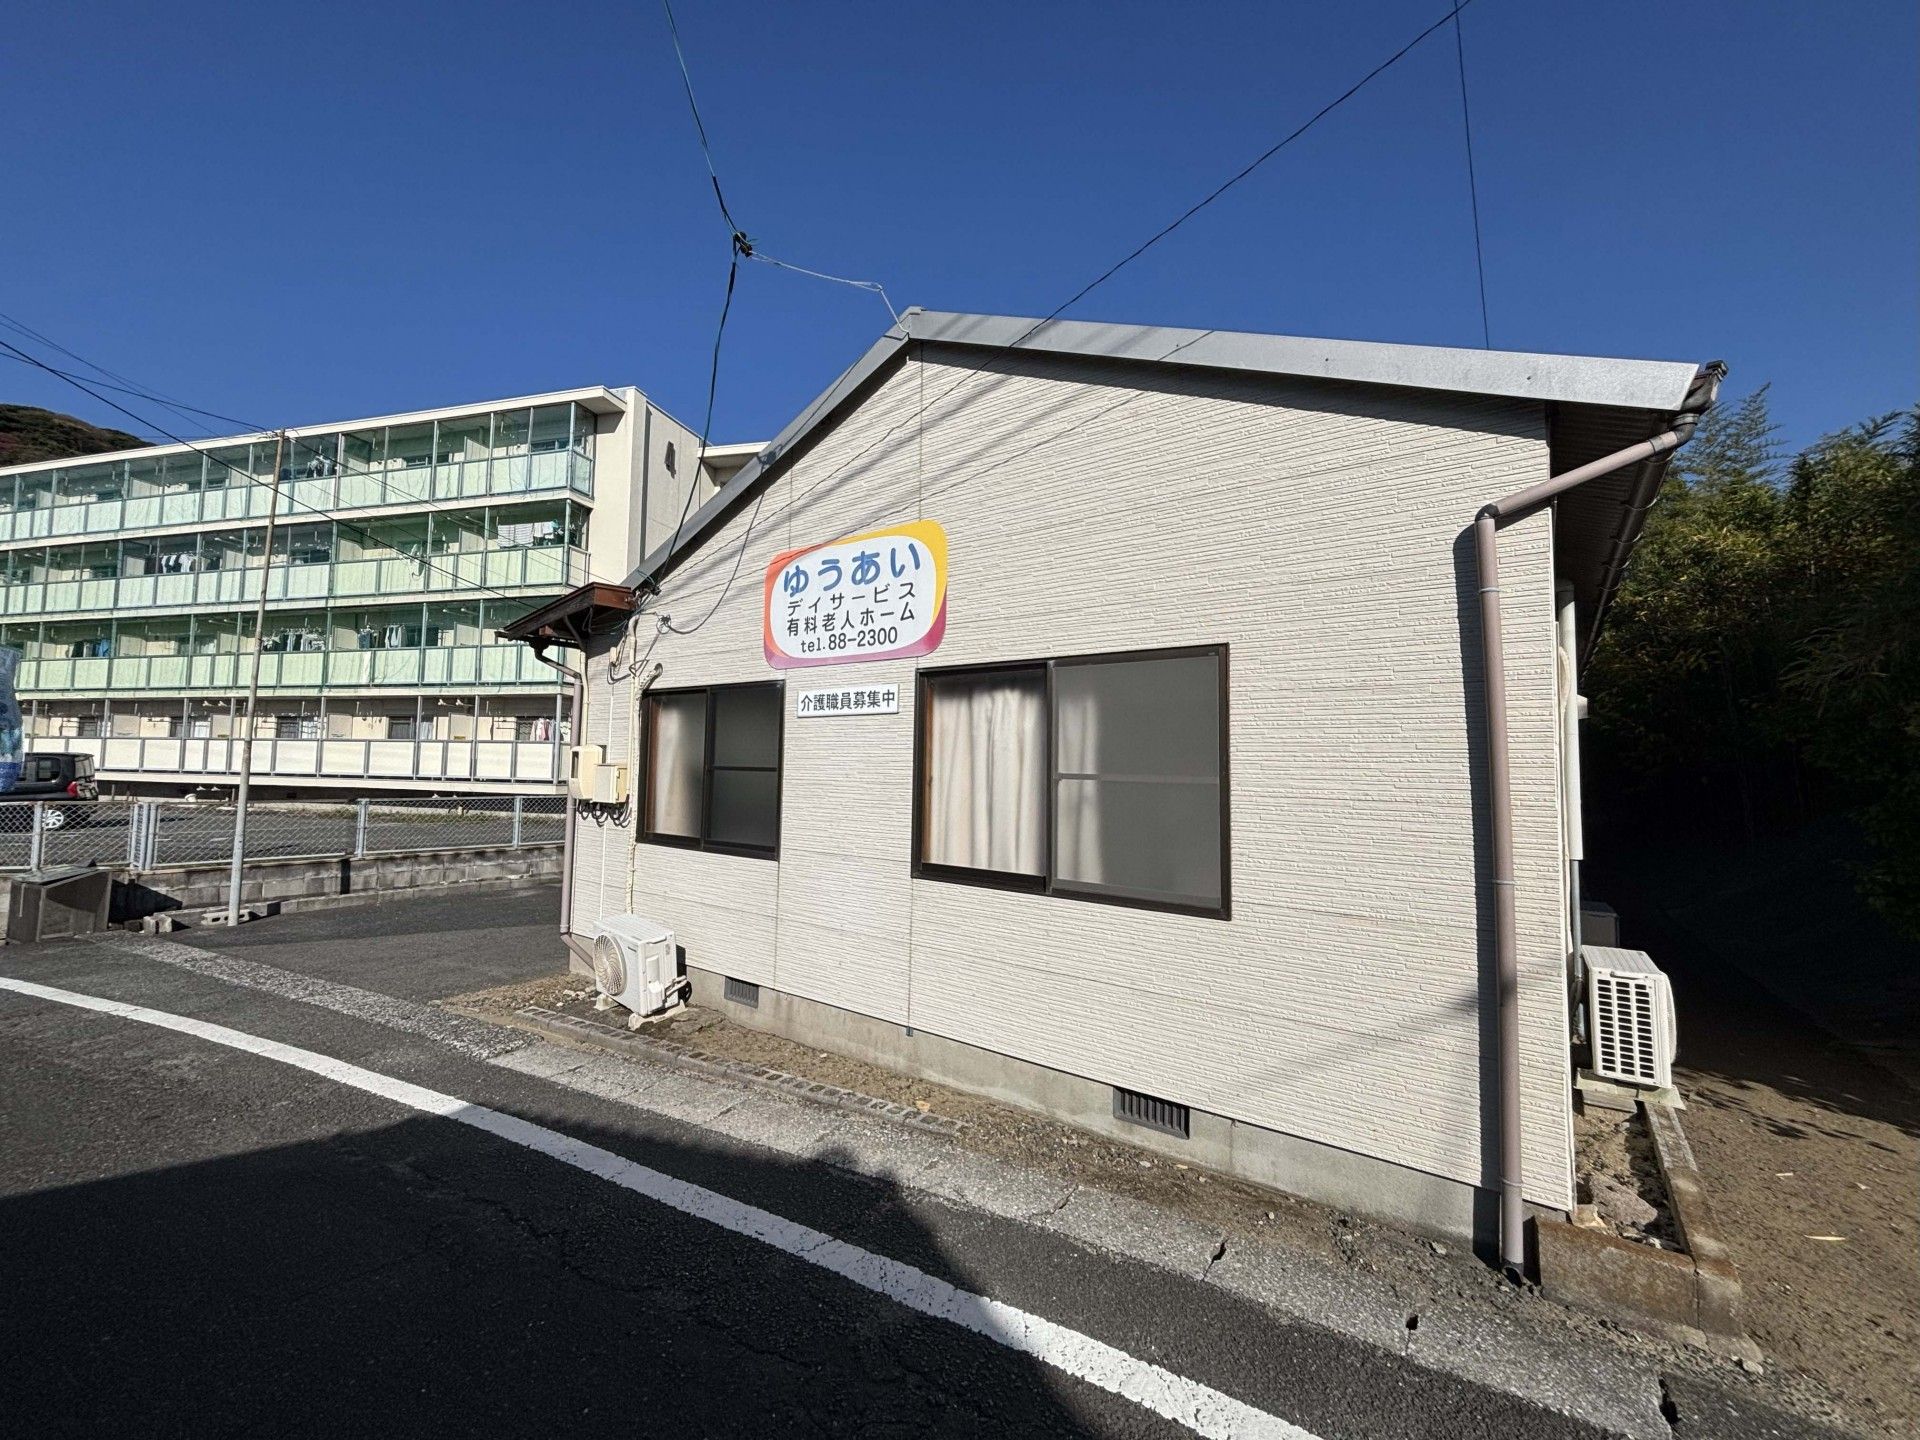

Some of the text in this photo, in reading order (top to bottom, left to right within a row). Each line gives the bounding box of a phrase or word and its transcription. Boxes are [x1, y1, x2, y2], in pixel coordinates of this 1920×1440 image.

[784, 543, 920, 598] ゆうあい
[787, 582, 916, 617] デイサービス
[786, 601, 915, 637] 有料老人ホーム
[800, 689, 896, 713] 介護職員募集中
